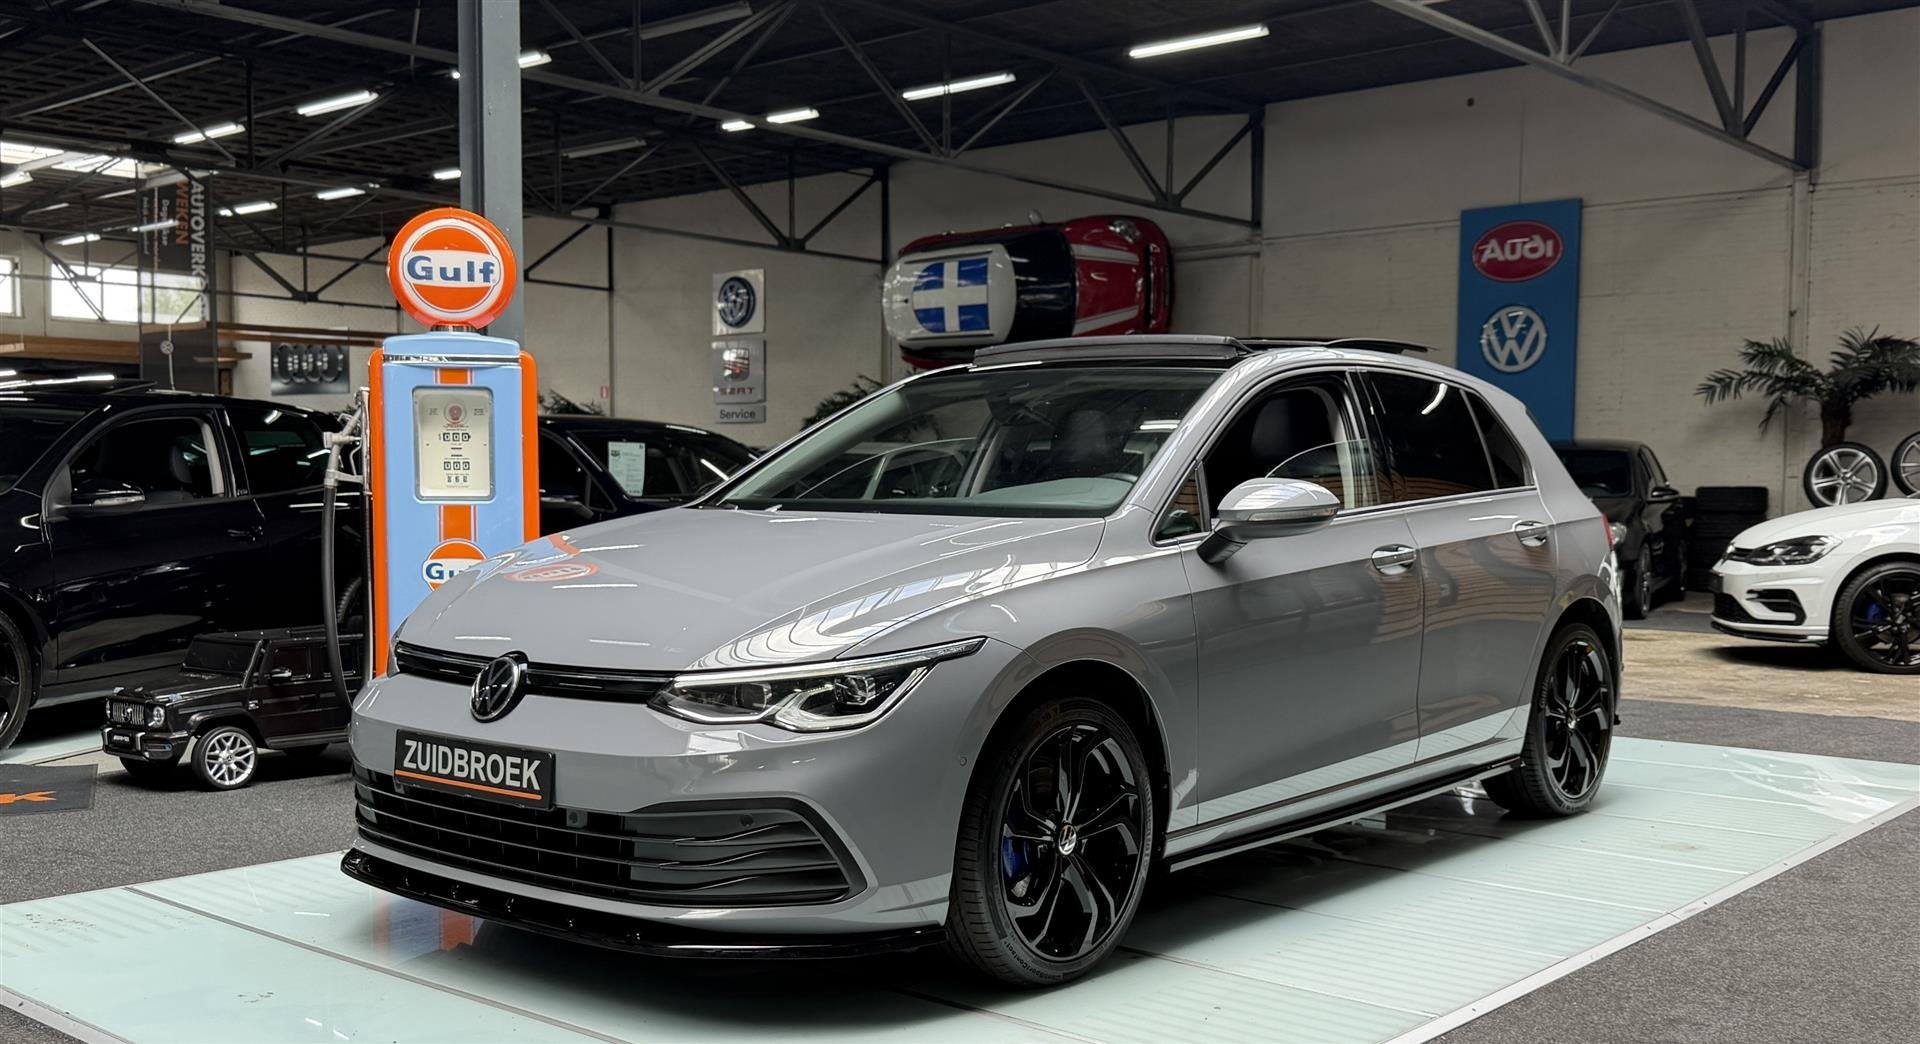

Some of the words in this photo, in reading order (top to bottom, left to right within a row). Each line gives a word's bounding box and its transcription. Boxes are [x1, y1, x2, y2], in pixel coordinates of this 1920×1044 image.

[175, 181, 189, 245] WEKEN
[407, 255, 495, 283] Gulf
[719, 409, 756, 420] Service
[402, 739, 542, 791] ZUIDBROEK
